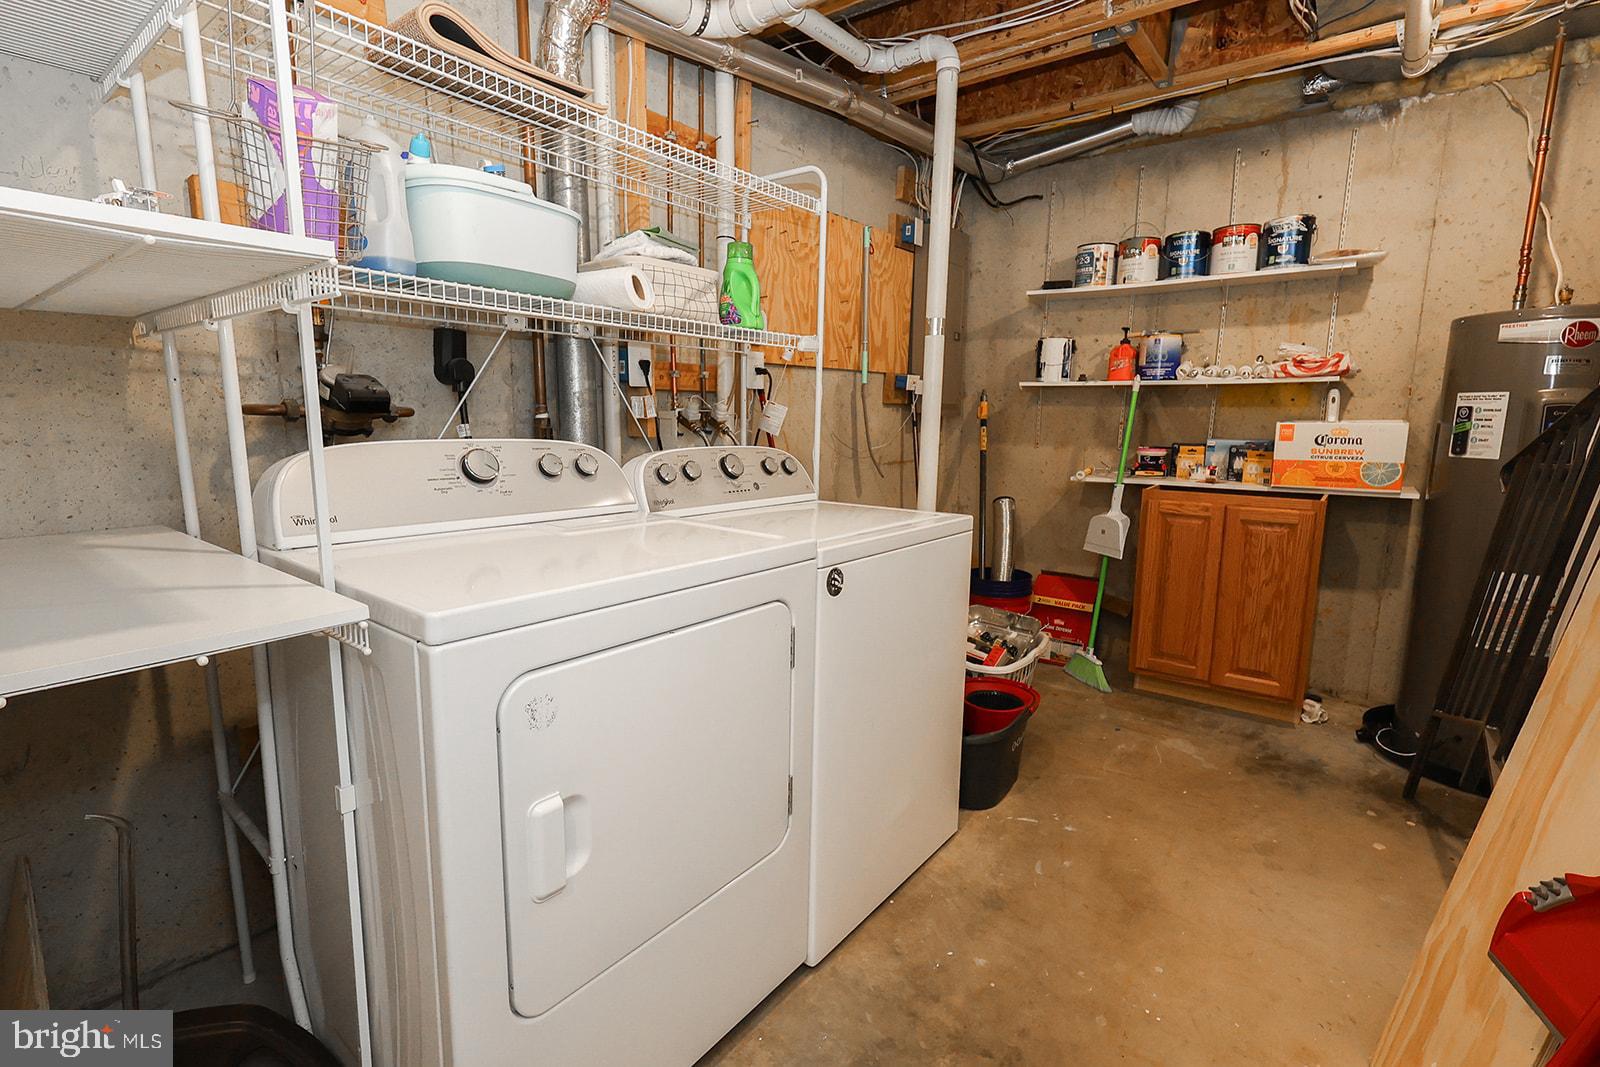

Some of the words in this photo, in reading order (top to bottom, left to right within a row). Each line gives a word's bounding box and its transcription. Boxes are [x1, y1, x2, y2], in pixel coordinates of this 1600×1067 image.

[1267, 235, 1304, 245] SIGNATURE
[1169, 248, 1201, 257] SIGNATURE
[1564, 320, 1597, 345] Rheem
[1314, 433, 1363, 448] Corona
[1311, 447, 1366, 456] SUNBREW
[292, 515, 338, 527] Whirol
[1054, 600, 1071, 608] VALUE
